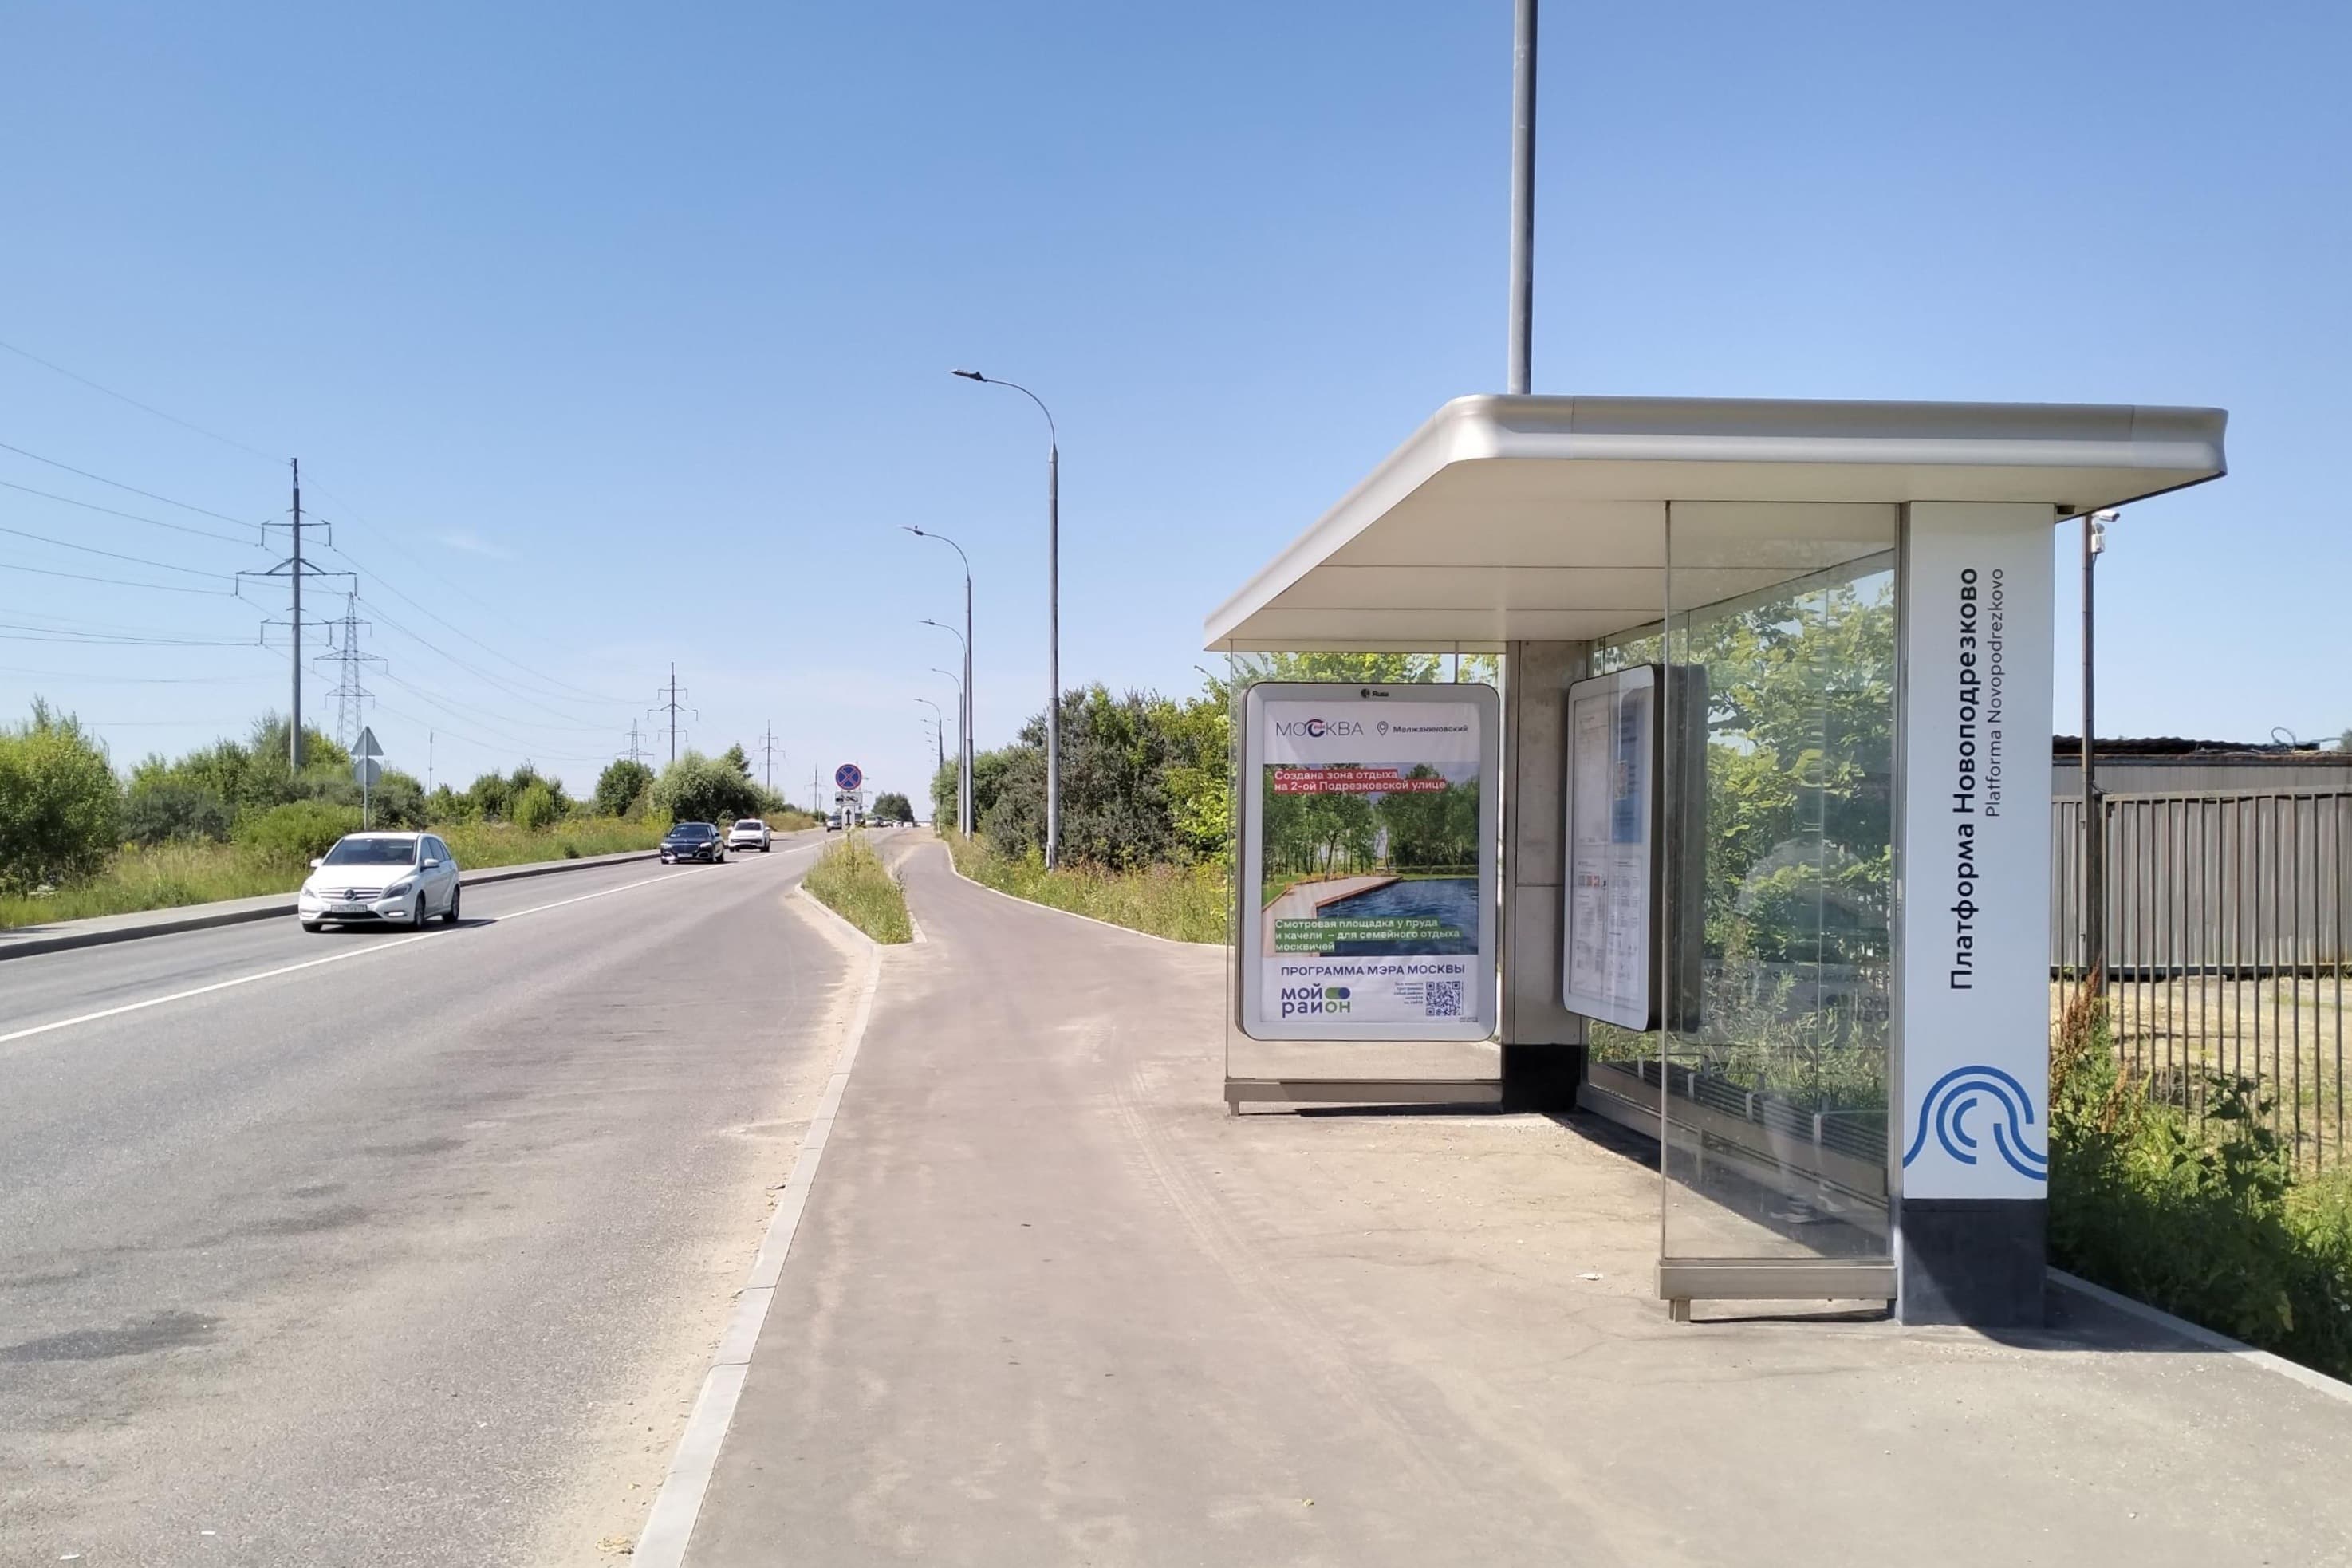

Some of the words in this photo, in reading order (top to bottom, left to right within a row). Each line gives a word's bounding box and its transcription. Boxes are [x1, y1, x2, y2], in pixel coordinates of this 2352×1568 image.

[1986, 568, 2006, 723] Novopodrezkovo
[1952, 567, 1980, 814] Новоподрезково
[1276, 719, 1363, 738] МОСКВА
[1274, 770, 1324, 781] Создана
[1356, 770, 1397, 780] отдыха
[1985, 727, 2003, 817] Platforma
[1290, 782, 1316, 790] 2-ой
[1319, 781, 1408, 792] Подрезковской
[1412, 781, 1447, 790] улице
[1951, 821, 1979, 989] Платформа
[1275, 920, 1337, 930] Смотровая
[1339, 919, 1394, 929] площадка
[1397, 920, 1404, 928] у
[1359, 929, 1418, 940] семейного
[1420, 929, 1460, 938] отдыха
[1275, 942, 1335, 951] москвичей
[1281, 967, 1365, 976] ПРОГРАММА
[1367, 966, 1404, 975] МЭРА
[1406, 965, 1465, 975] МОСКВЫ
